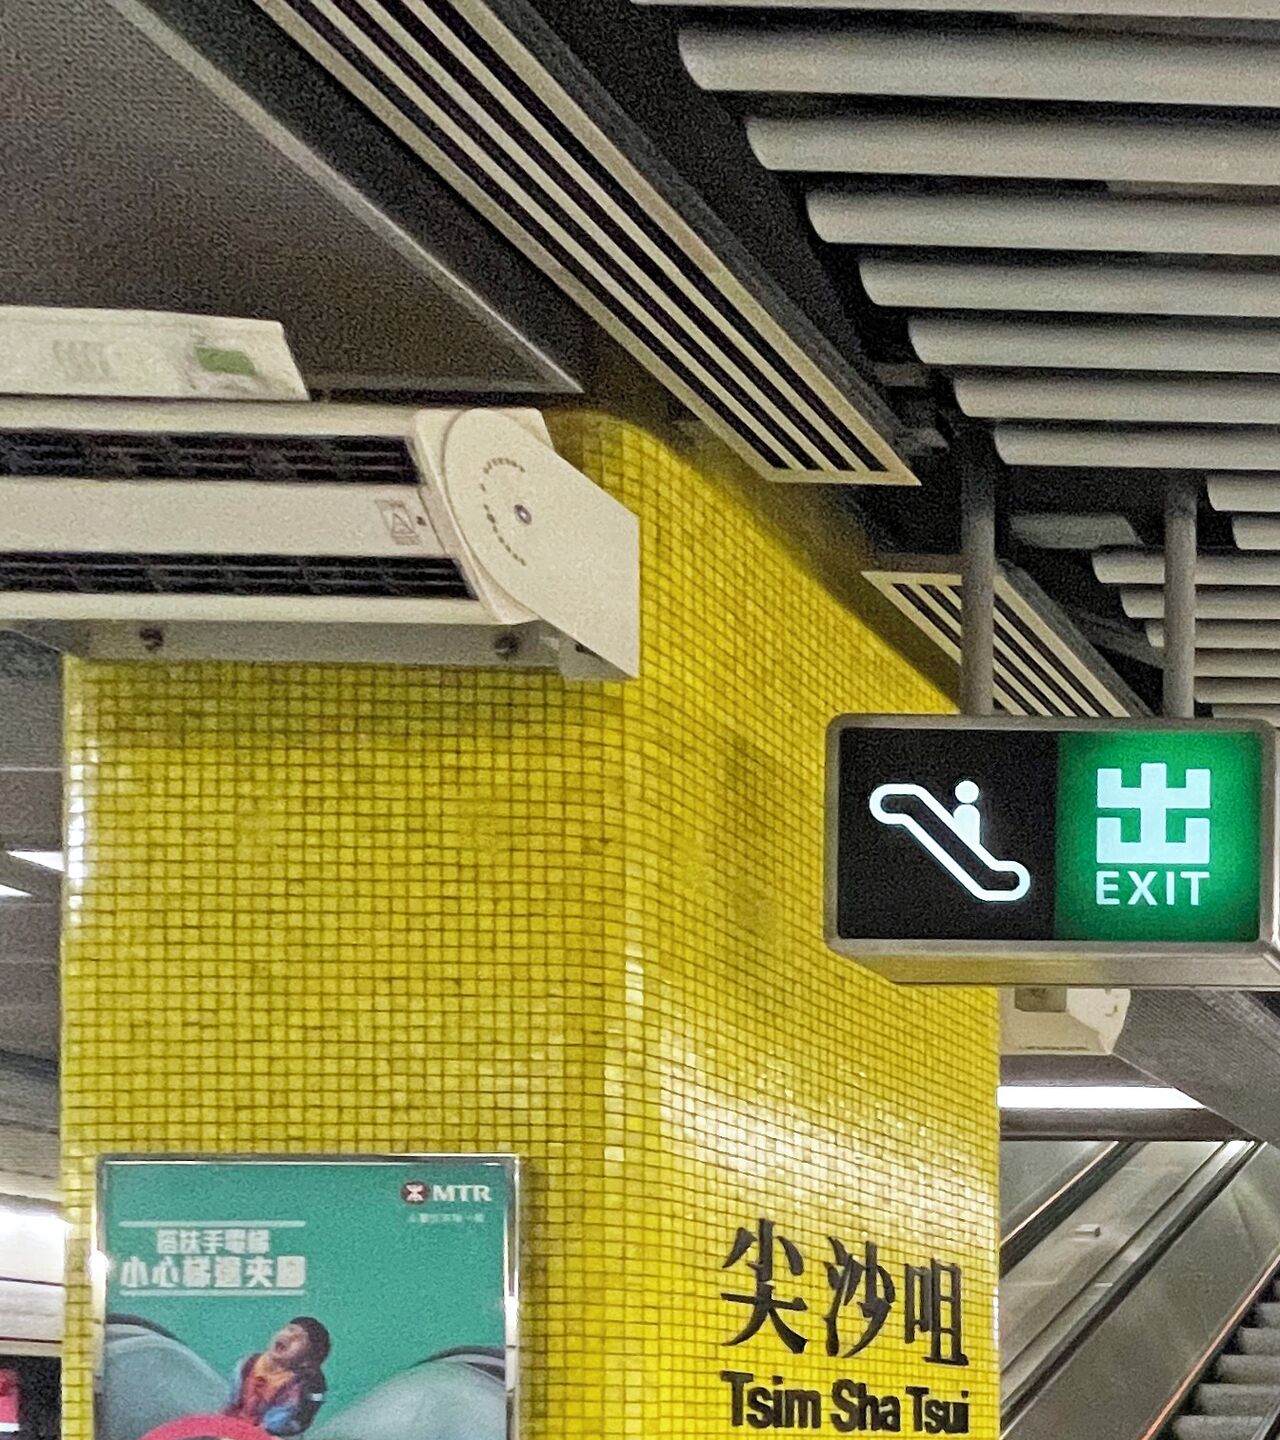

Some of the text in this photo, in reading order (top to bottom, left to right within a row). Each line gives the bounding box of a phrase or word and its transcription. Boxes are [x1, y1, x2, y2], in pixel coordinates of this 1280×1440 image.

[1096, 870, 1210, 906] EXIT
[433, 1184, 492, 1202] MTR
[720, 1218, 969, 1366] 尖沙咀
[720, 1370, 970, 1434] Tsim Sha Tsui
